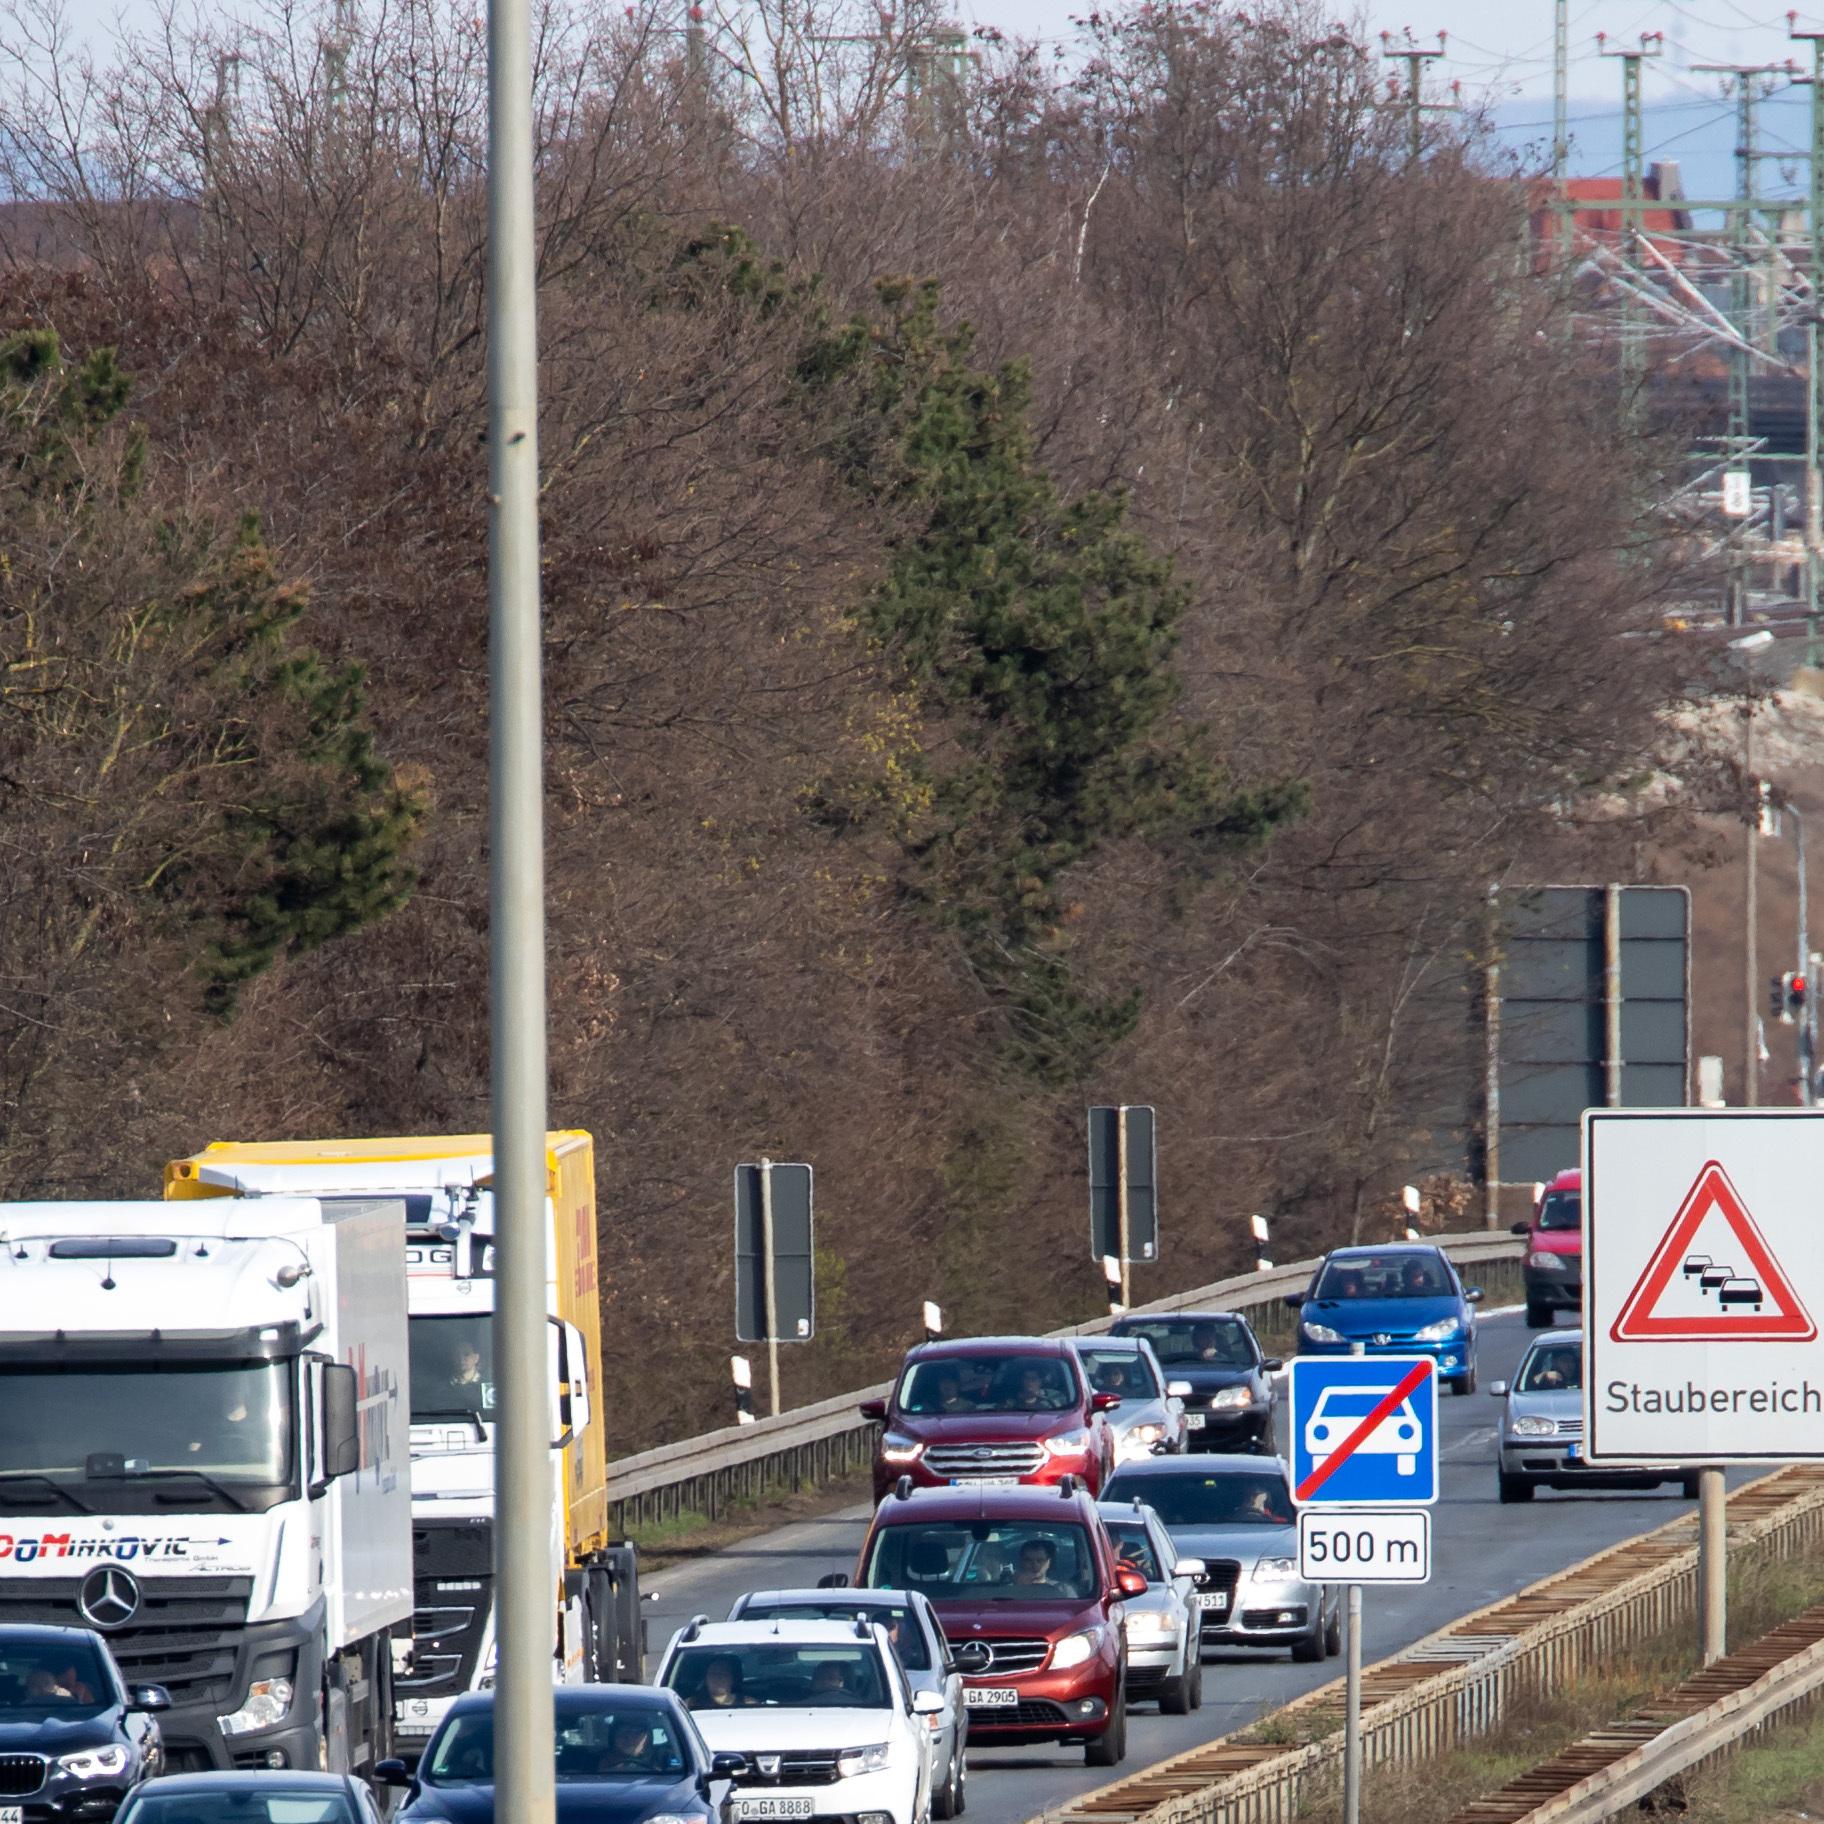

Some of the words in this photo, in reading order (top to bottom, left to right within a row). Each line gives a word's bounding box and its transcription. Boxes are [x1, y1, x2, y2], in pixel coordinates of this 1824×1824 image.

[1605, 1380, 1822, 1413] Staubereich
[1310, 1531, 1374, 1562] 500
[1387, 1540, 1418, 1562] m
[987, 1691, 1016, 1703] 2905
[759, 1801, 776, 1815] GA
[779, 1801, 811, 1815] 8888
